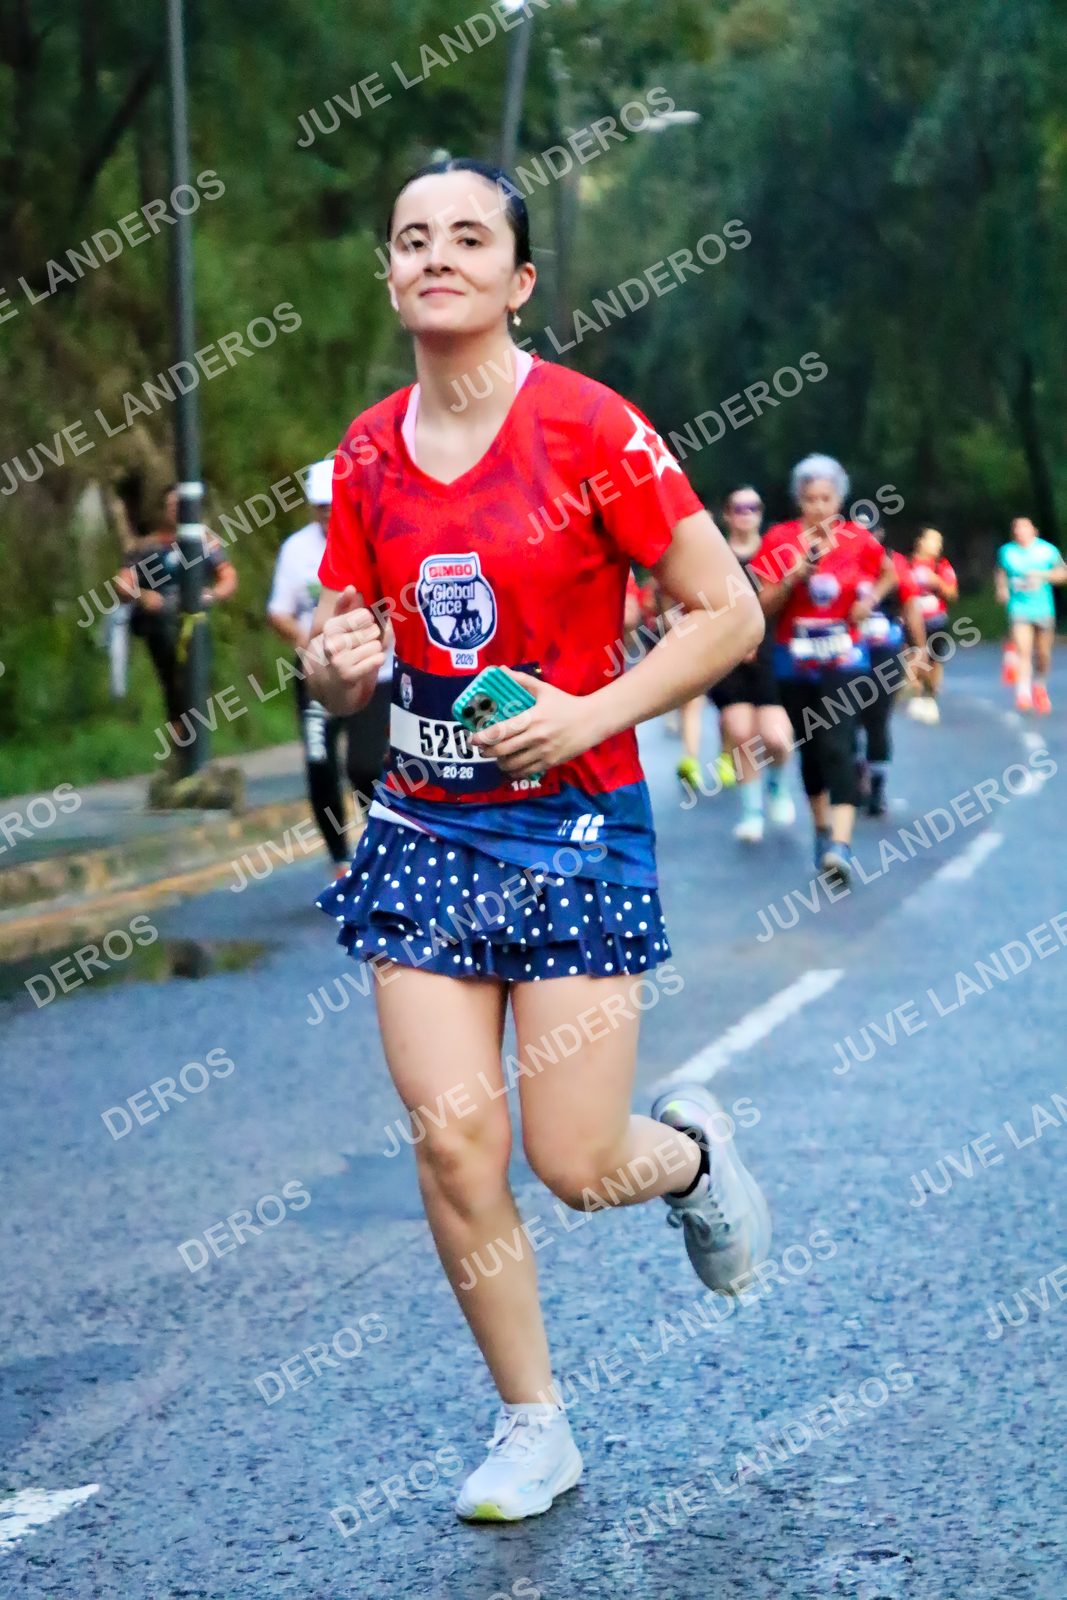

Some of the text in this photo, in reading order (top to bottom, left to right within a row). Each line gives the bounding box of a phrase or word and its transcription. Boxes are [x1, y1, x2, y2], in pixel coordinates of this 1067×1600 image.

[429, 564, 473, 578] BIMBO
[433, 581, 475, 601] Global
[430, 600, 462, 616] Race
[455, 653, 475, 665] 2026
[419, 720, 490, 759] 520
